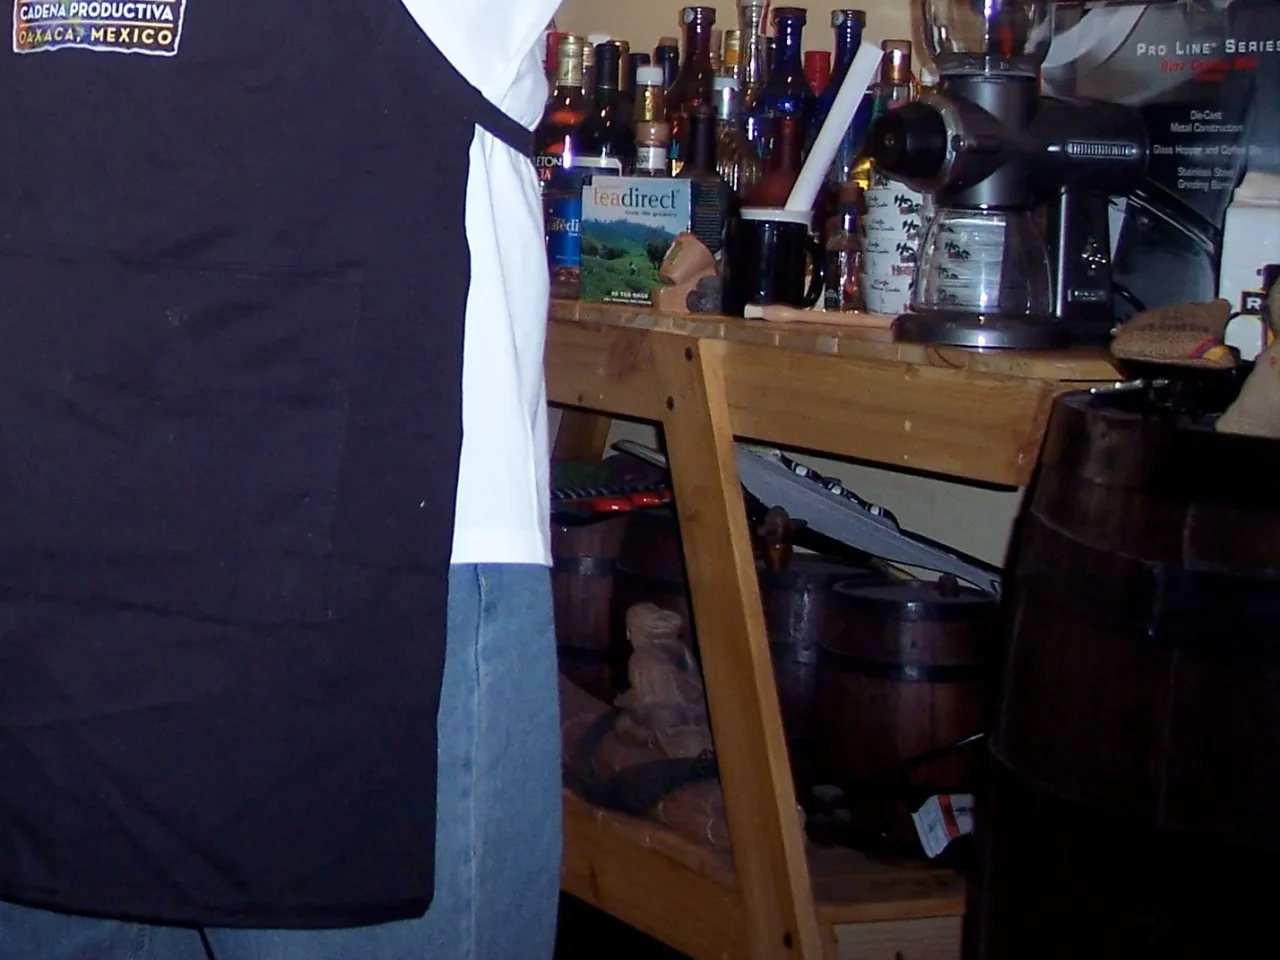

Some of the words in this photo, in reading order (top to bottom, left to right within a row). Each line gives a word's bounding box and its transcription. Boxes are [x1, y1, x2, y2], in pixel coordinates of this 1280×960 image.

[20, 3, 66, 20] CADENA
[70, 2, 174, 21] PRODUCTIVA
[20, 26, 81, 44] OAXACA,
[91, 27, 173, 45] MEXICO
[593, 187, 677, 209] teadirect
